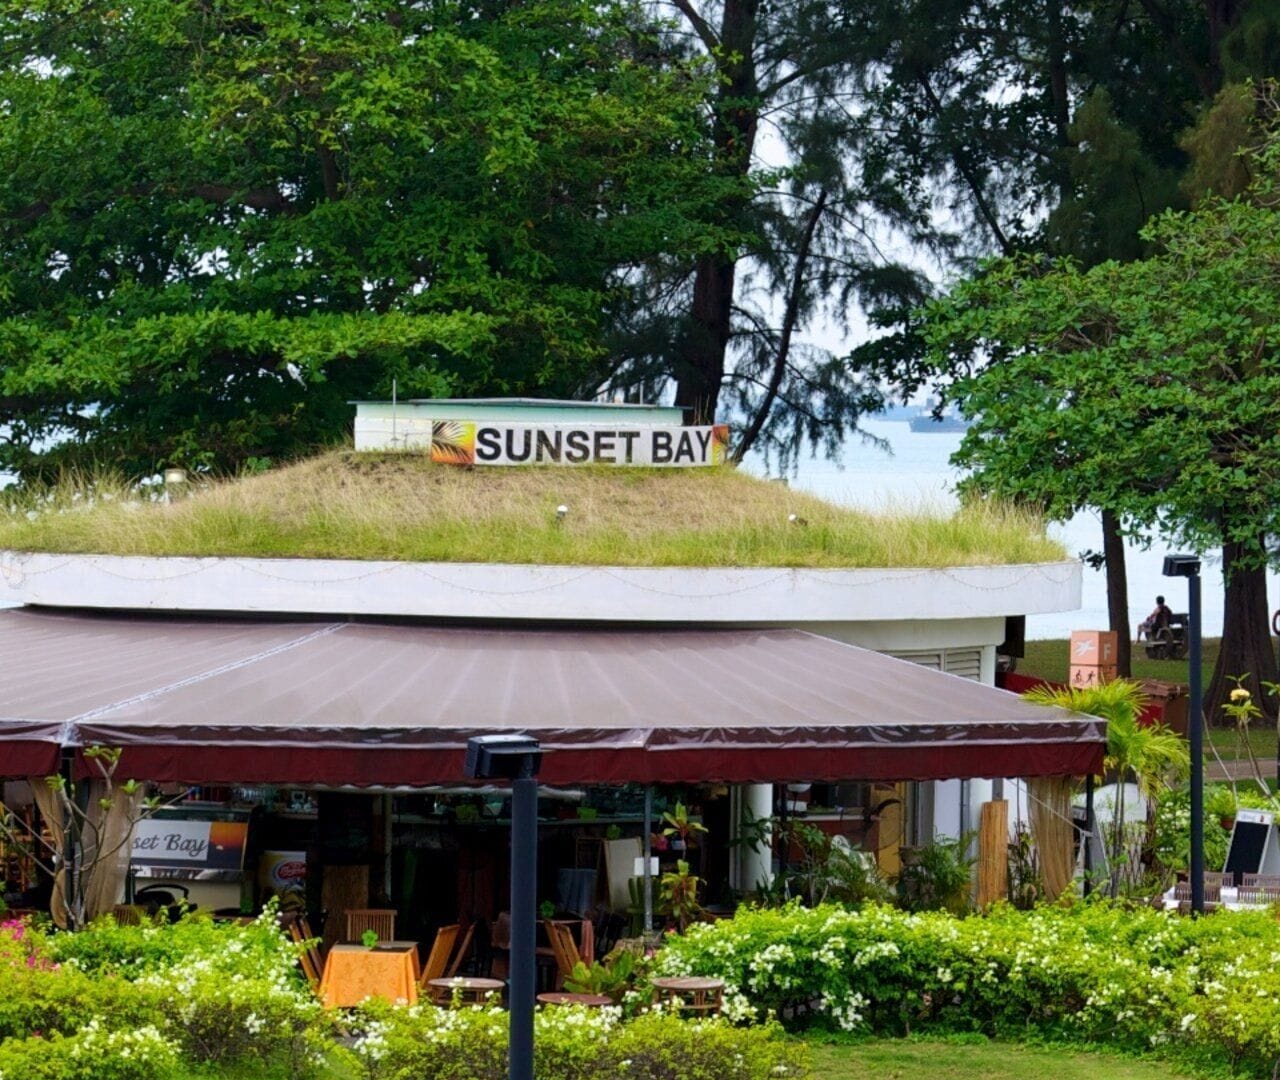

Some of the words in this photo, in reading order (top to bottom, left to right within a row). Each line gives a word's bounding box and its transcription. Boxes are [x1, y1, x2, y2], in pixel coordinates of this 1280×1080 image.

[476, 427, 640, 464] SUNSET
[652, 430, 712, 463] BAY
[131, 834, 160, 850] set
[163, 833, 208, 857] Bay
